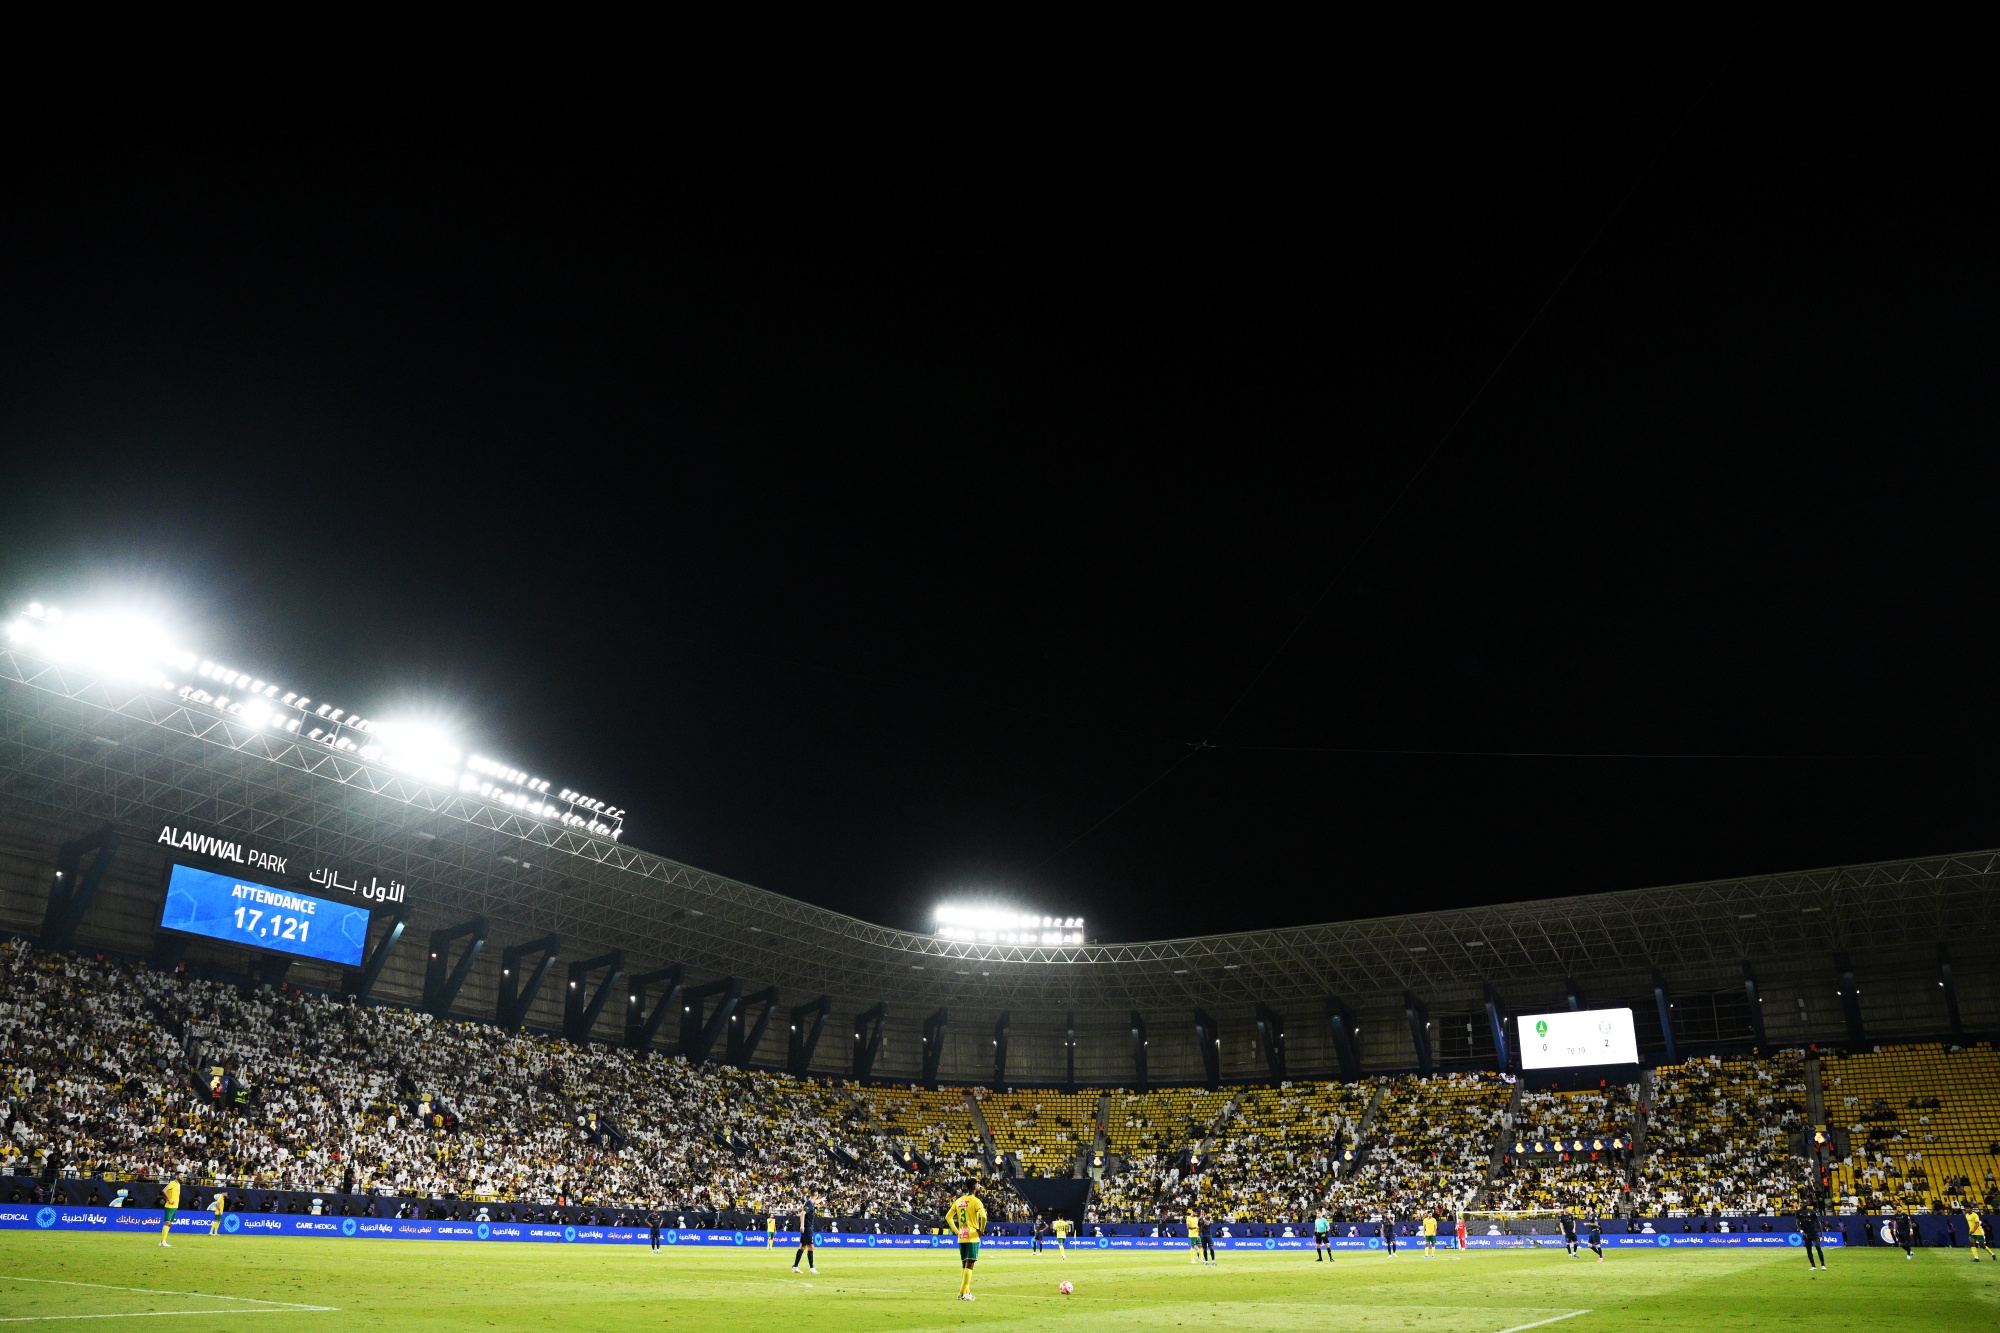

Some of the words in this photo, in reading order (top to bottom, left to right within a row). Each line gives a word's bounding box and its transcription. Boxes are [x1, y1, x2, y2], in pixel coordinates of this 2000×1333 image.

[158, 825, 245, 863] ALAWWAL
[247, 849, 288, 874] PARK
[308, 868, 358, 895] بارك
[362, 876, 405, 903] الأول
[231, 884, 317, 915] ATTENDANCE
[233, 906, 310, 942] 17,121
[1542, 1043, 1548, 1052] 0
[1604, 1038, 1610, 1048] 2
[61, 1213, 88, 1224] الطبية
[87, 1213, 107, 1224] رعاية
[295, 1221, 314, 1229] CARE
[960, 1207, 967, 1225] 3
